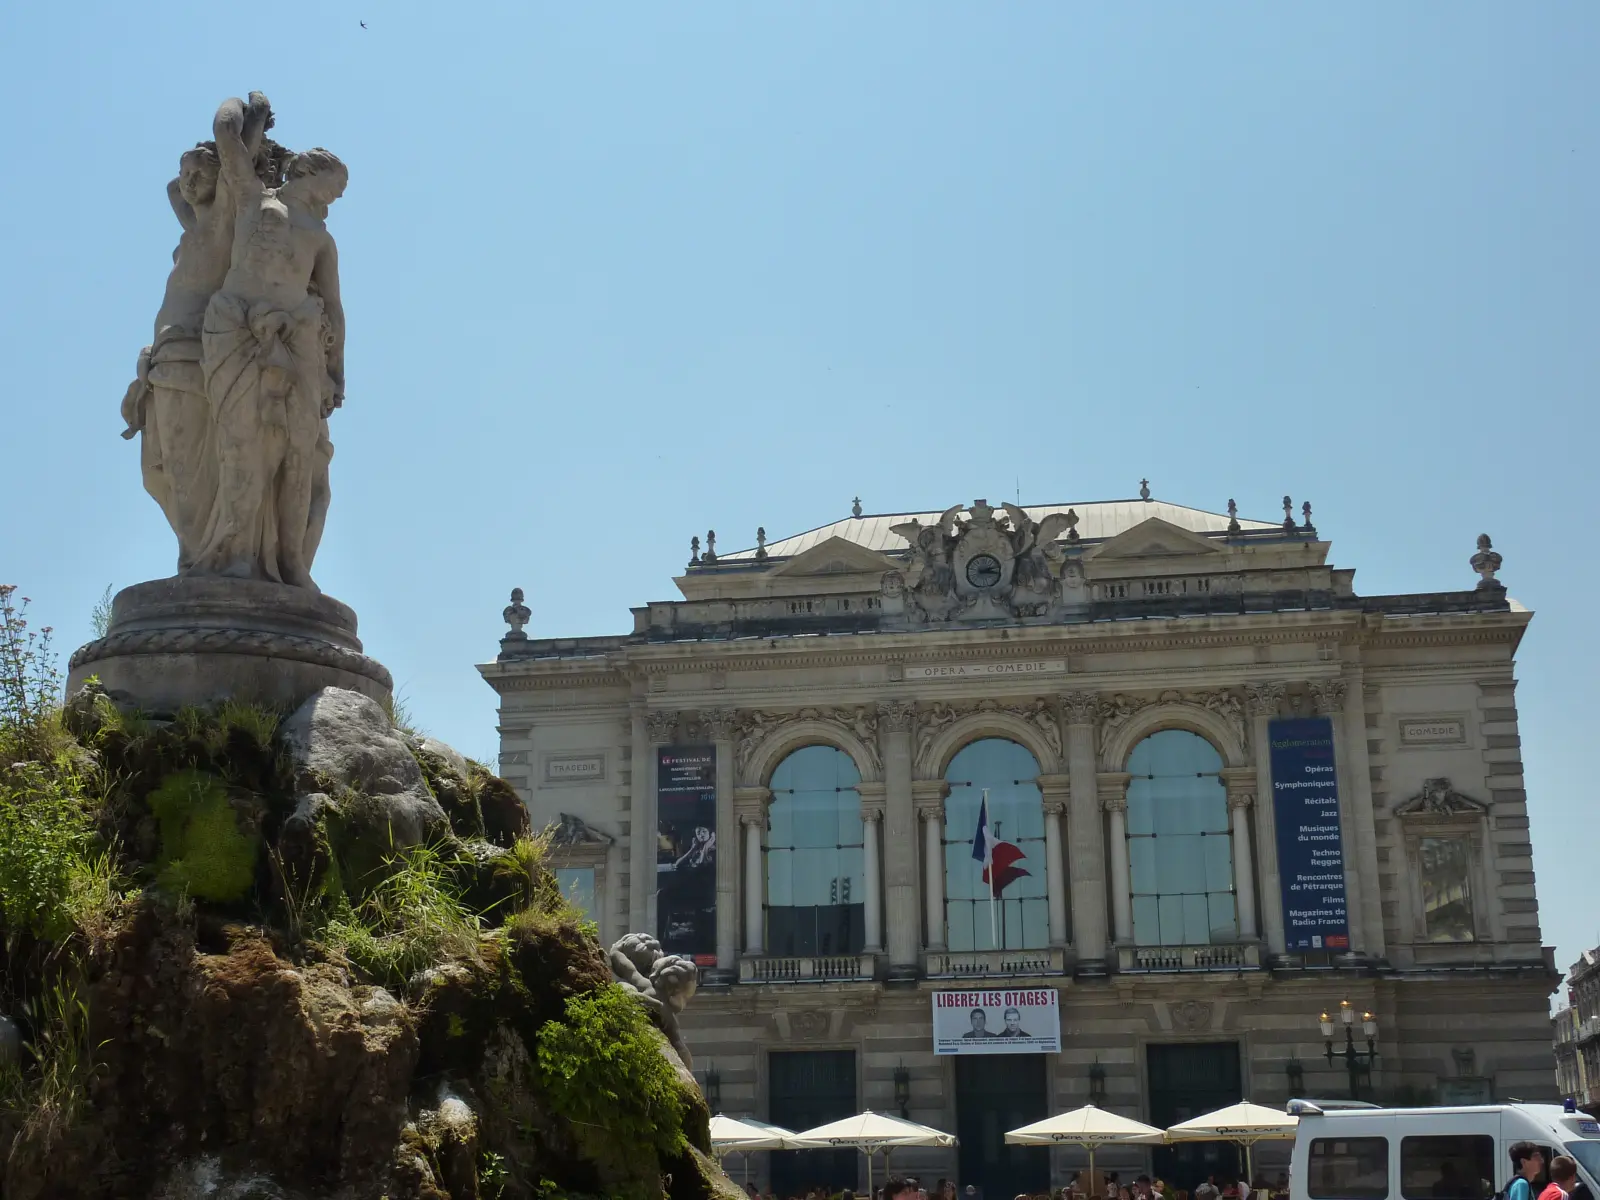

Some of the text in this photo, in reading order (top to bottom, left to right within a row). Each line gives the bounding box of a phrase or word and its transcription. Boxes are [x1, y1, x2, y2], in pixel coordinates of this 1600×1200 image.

[925, 666, 966, 676] OPERA
[987, 662, 1046, 673] COMEDIE
[1409, 727, 1454, 736] COMEDIE
[553, 763, 597, 773] TRAGEDIE
[1304, 765, 1334, 774] Opéras
[1274, 780, 1335, 790] Symphoniques
[1304, 797, 1337, 805] Récitals
[1299, 824, 1339, 833] Musiques
[1297, 834, 1309, 842] du
[1312, 849, 1341, 857] Techno
[1310, 858, 1342, 867] Reggae
[1290, 883, 1344, 891] de Pétrarque
[1322, 896, 1345, 904] Films
[1289, 908, 1333, 918] Magazines
[1292, 918, 1316, 926] Radio
[936, 992, 980, 1008] LIBEREZ
[983, 992, 1001, 1007] LES
[1004, 991, 1048, 1007] OTAGES
